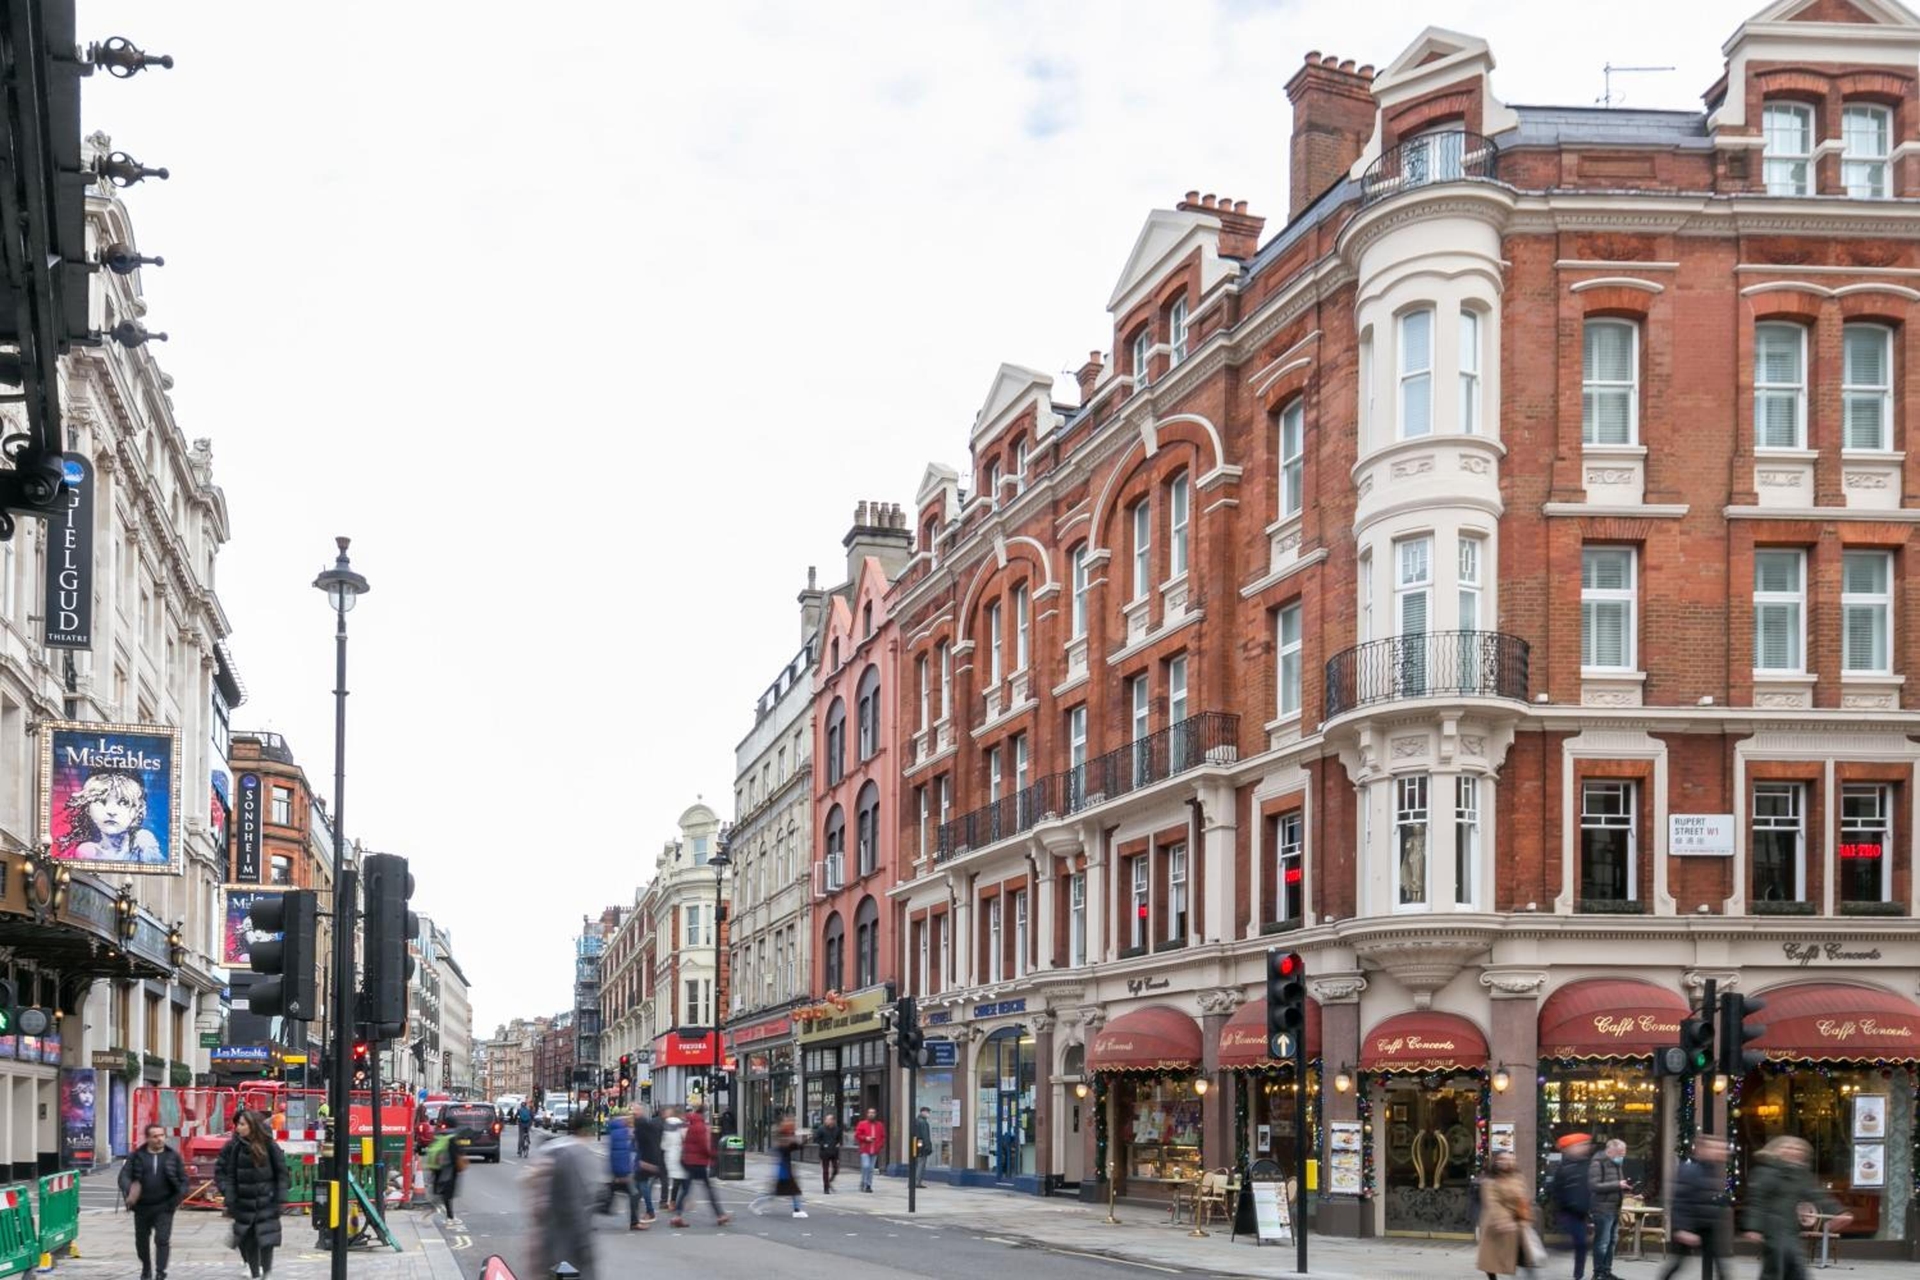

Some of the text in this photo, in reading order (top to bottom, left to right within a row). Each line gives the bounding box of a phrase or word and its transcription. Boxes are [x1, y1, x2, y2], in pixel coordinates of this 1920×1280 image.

[59, 488, 80, 631] GIELGUD
[48, 633, 88, 643] THEATRE
[100, 738, 124, 754] Les
[1674, 817, 1707, 827] RUPERT
[243, 790, 255, 874] SONDHEIM
[1674, 827, 1720, 836] STREET W1
[1824, 942, 1882, 961] Concerto
[1638, 1015, 1682, 1032] Concer
[1859, 1019, 1913, 1037] Concerto
[1406, 1036, 1455, 1051] Concerto
